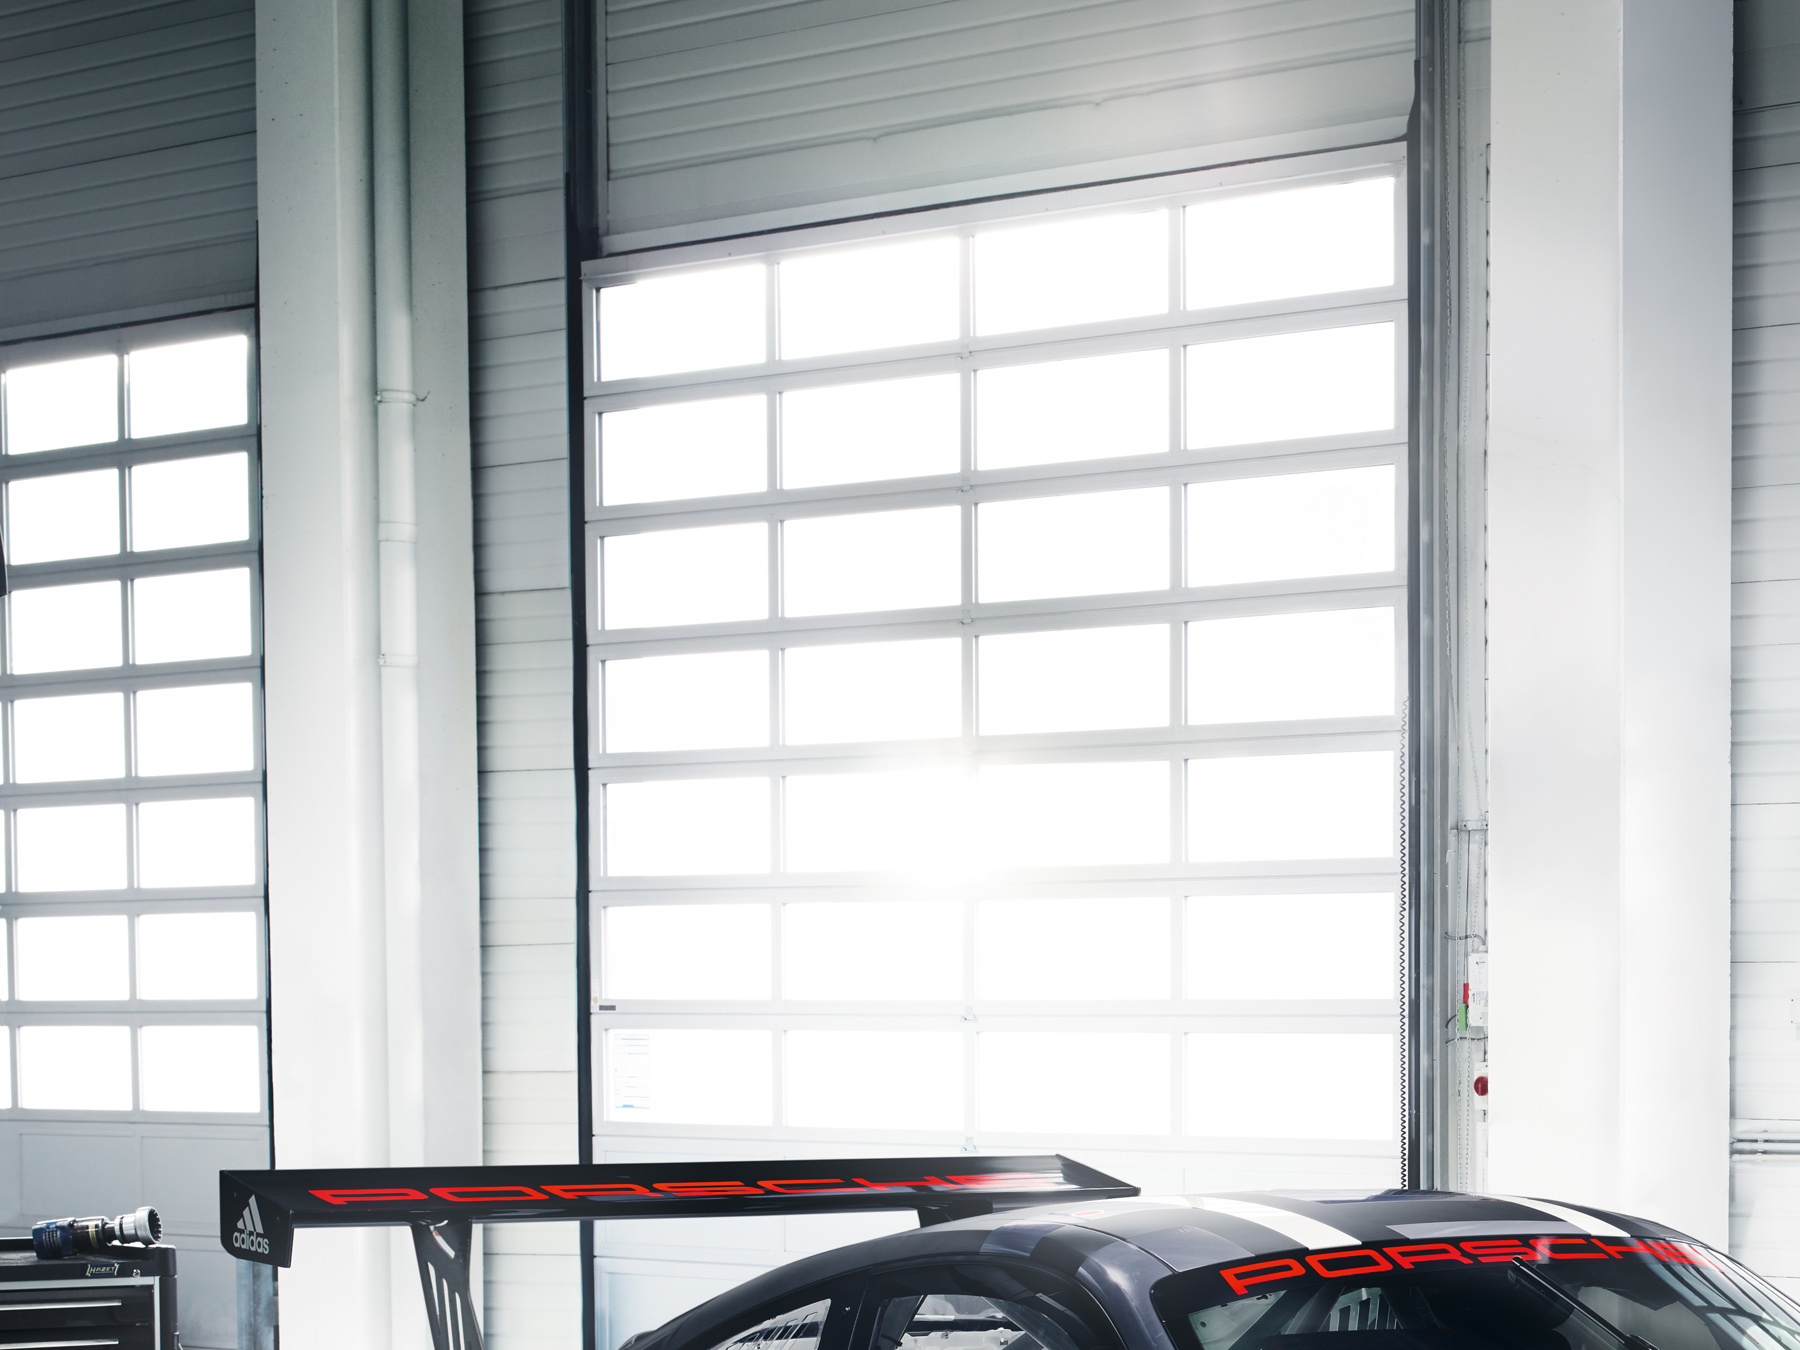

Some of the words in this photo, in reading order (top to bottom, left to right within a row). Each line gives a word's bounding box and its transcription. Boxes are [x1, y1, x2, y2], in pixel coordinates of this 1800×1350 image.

[307, 1173, 1060, 1206] PORSCHE
[232, 1228, 270, 1255] adidas
[1219, 1237, 1724, 1296] PORSCHE
